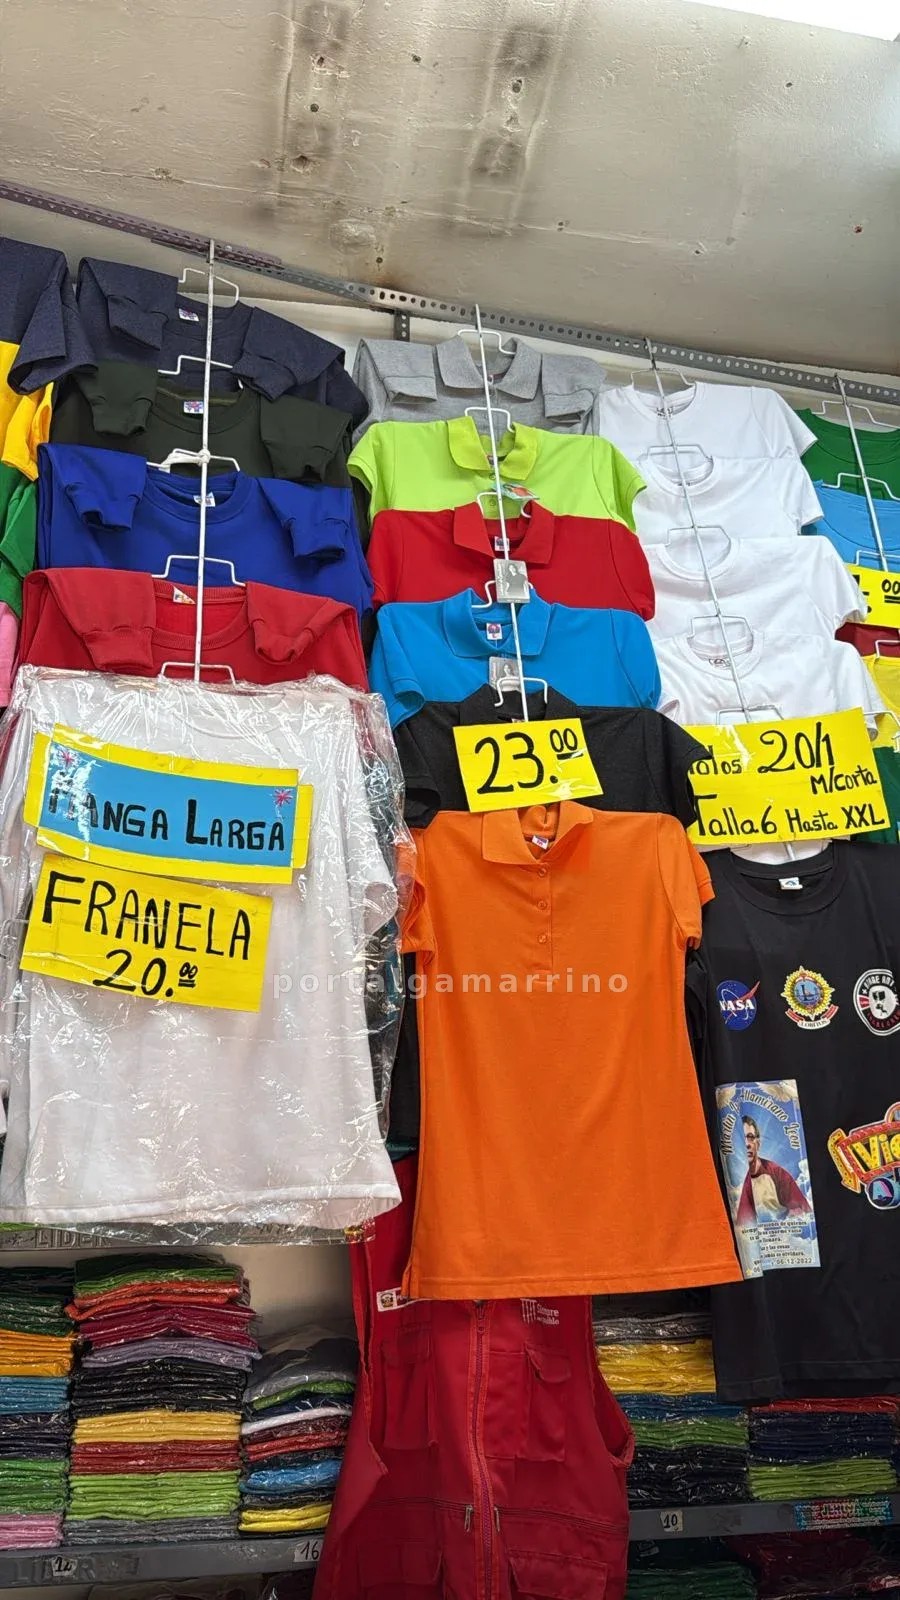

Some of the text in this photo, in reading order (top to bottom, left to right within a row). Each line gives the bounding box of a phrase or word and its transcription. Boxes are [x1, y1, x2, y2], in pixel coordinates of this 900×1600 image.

[475, 727, 584, 795] 23.00
[690, 747, 743, 775] olos
[185, 799, 285, 851] LARGA
[841, 803, 885, 830] XXL
[42, 870, 252, 961] FRANELA
[93, 949, 200, 998] 20.00
[719, 998, 756, 1012] NASA
[663, 1513, 678, 1529] 10
[300, 1541, 319, 1560] 16
